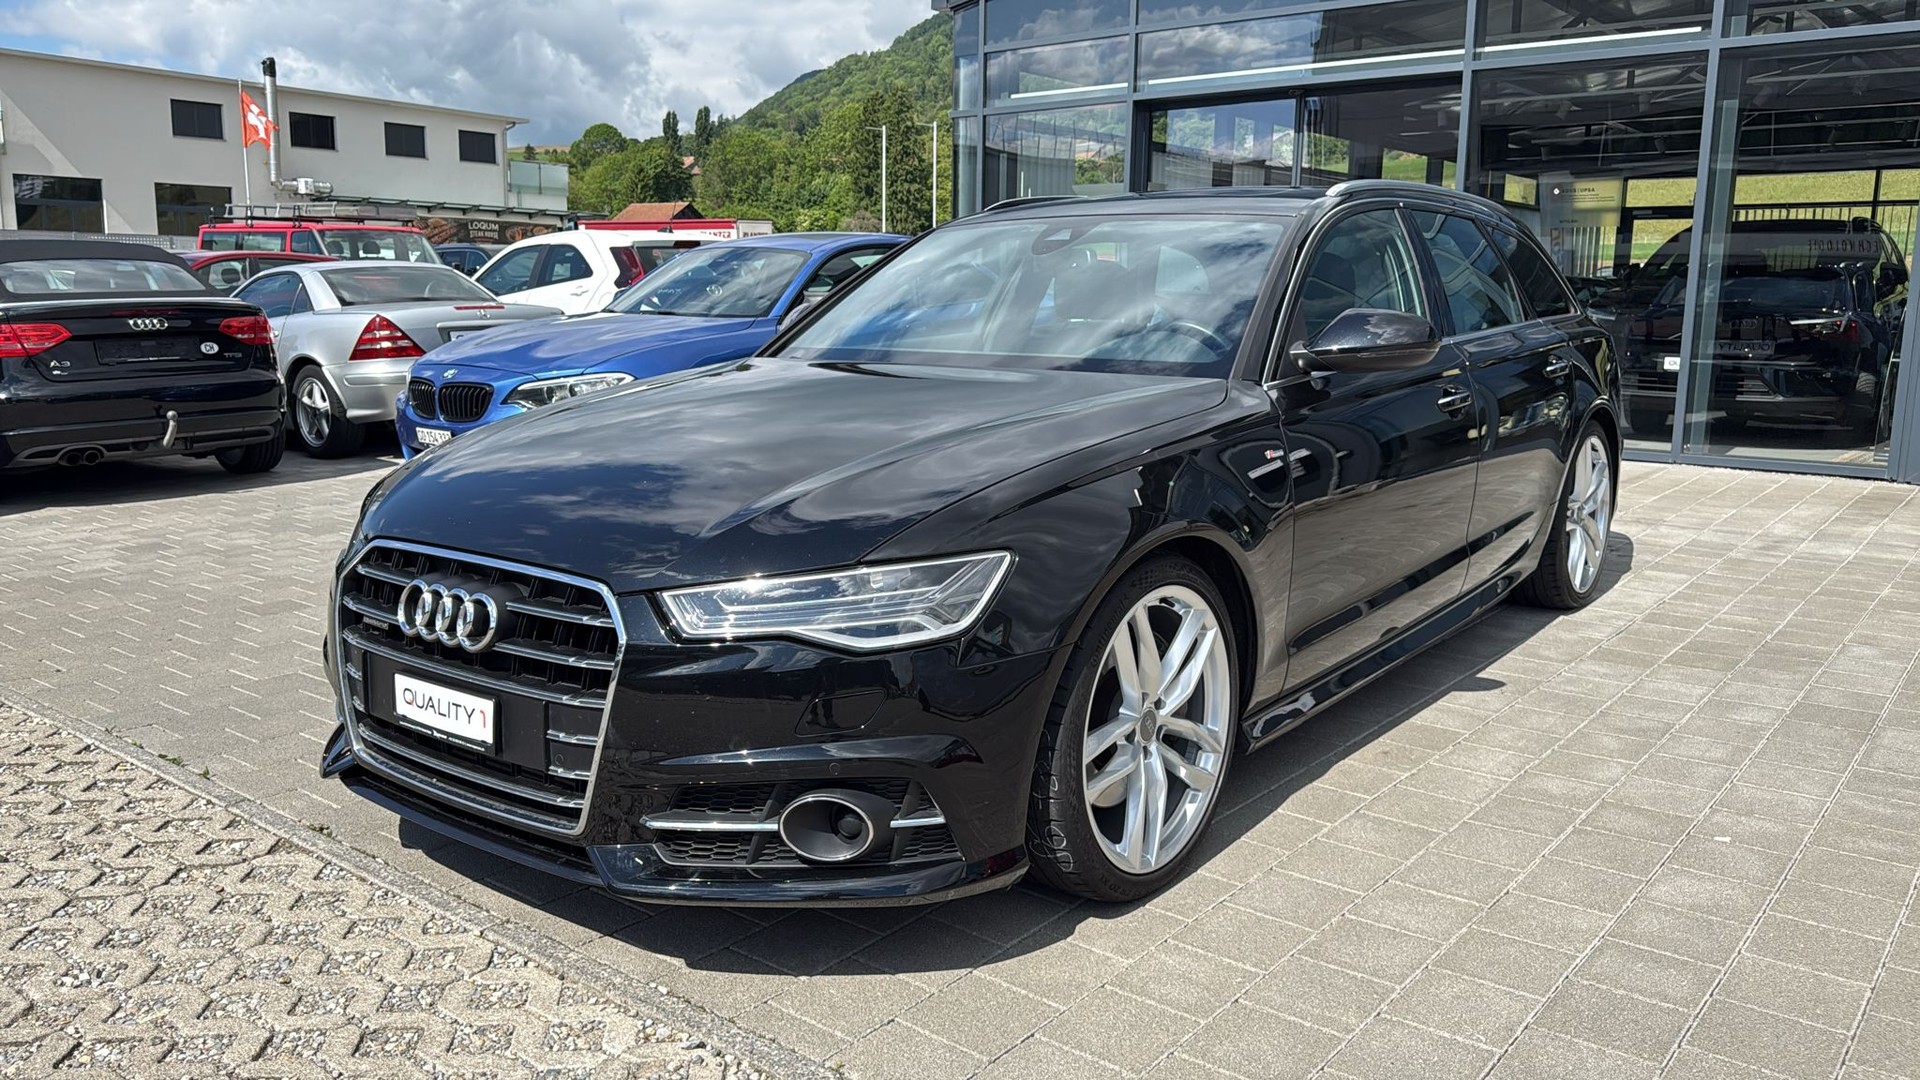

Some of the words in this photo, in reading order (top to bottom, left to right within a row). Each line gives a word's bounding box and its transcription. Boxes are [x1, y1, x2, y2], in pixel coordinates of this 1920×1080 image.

[468, 221, 499, 231] LOQUM
[50, 360, 71, 368] A3
[403, 687, 476, 725] QUALITY
[479, 709, 487, 729] 1
